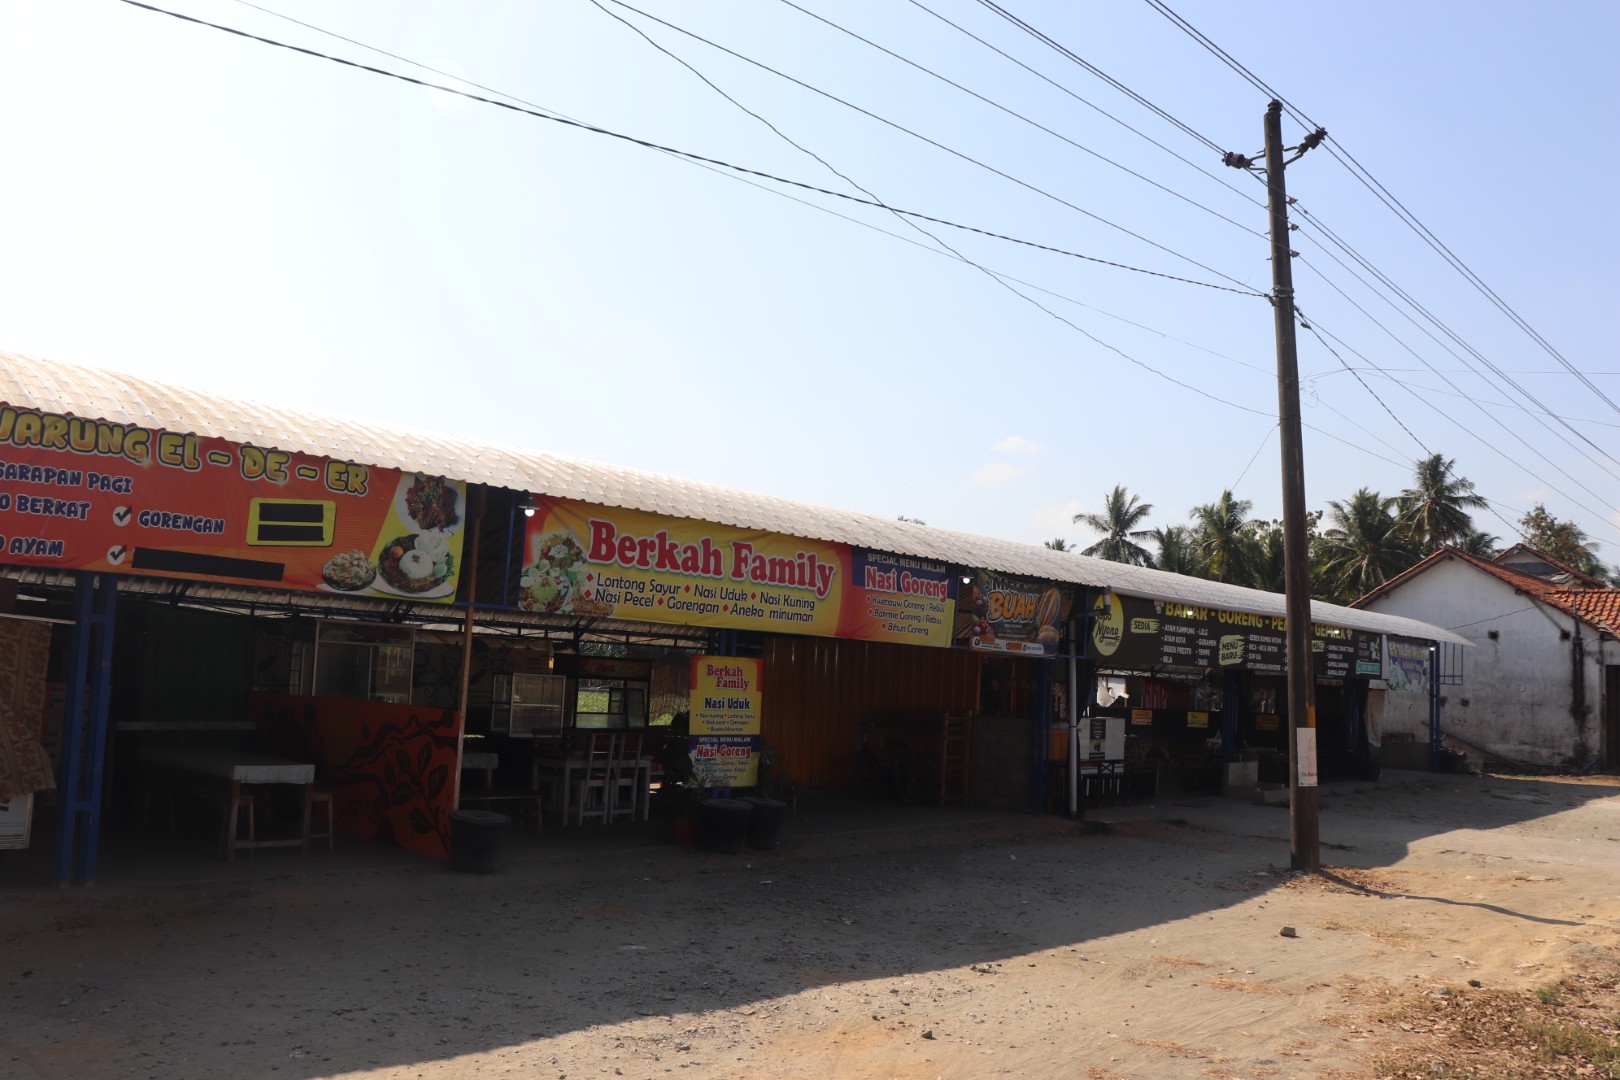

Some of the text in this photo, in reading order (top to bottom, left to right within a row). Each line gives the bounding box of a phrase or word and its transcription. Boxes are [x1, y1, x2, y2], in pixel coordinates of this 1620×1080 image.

[158, 431, 202, 471] EL
[240, 444, 290, 484] DE
[325, 460, 368, 497] ER
[88, 472, 133, 494] PAGI
[16, 494, 91, 520] BERKAT
[138, 510, 225, 534] GORENGAN
[9, 537, 64, 557] AYAM
[587, 517, 836, 600] Berkah Family
[867, 553, 946, 574] SPECIAL MENU MALAM
[597, 573, 681, 597] Lontong Sayur
[694, 584, 748, 603] Nasi Uduk
[865, 565, 948, 604] Nasi Goreng
[594, 590, 655, 608] Nasi Pecel
[667, 597, 720, 615] Gorengan
[760, 592, 816, 611] Nasi Kuning
[903, 600, 925, 612] Goreng
[986, 590, 1038, 623] BUAH
[730, 604, 814, 623] Aneka minuman
[899, 611, 921, 624] Goreng
[1218, 610, 1264, 628] GORENG
[887, 622, 929, 636] Bihun Goreng
[1133, 620, 1151, 631] SEDIA
[1176, 626, 1195, 635] KAMPUNG
[1221, 641, 1238, 651] MENU
[1221, 651, 1238, 661] BARU
[706, 664, 743, 677] Berkah
[716, 677, 750, 691] Family
[704, 697, 751, 710] Nasi Uduk
[696, 744, 752, 760] Nasi Goreng
